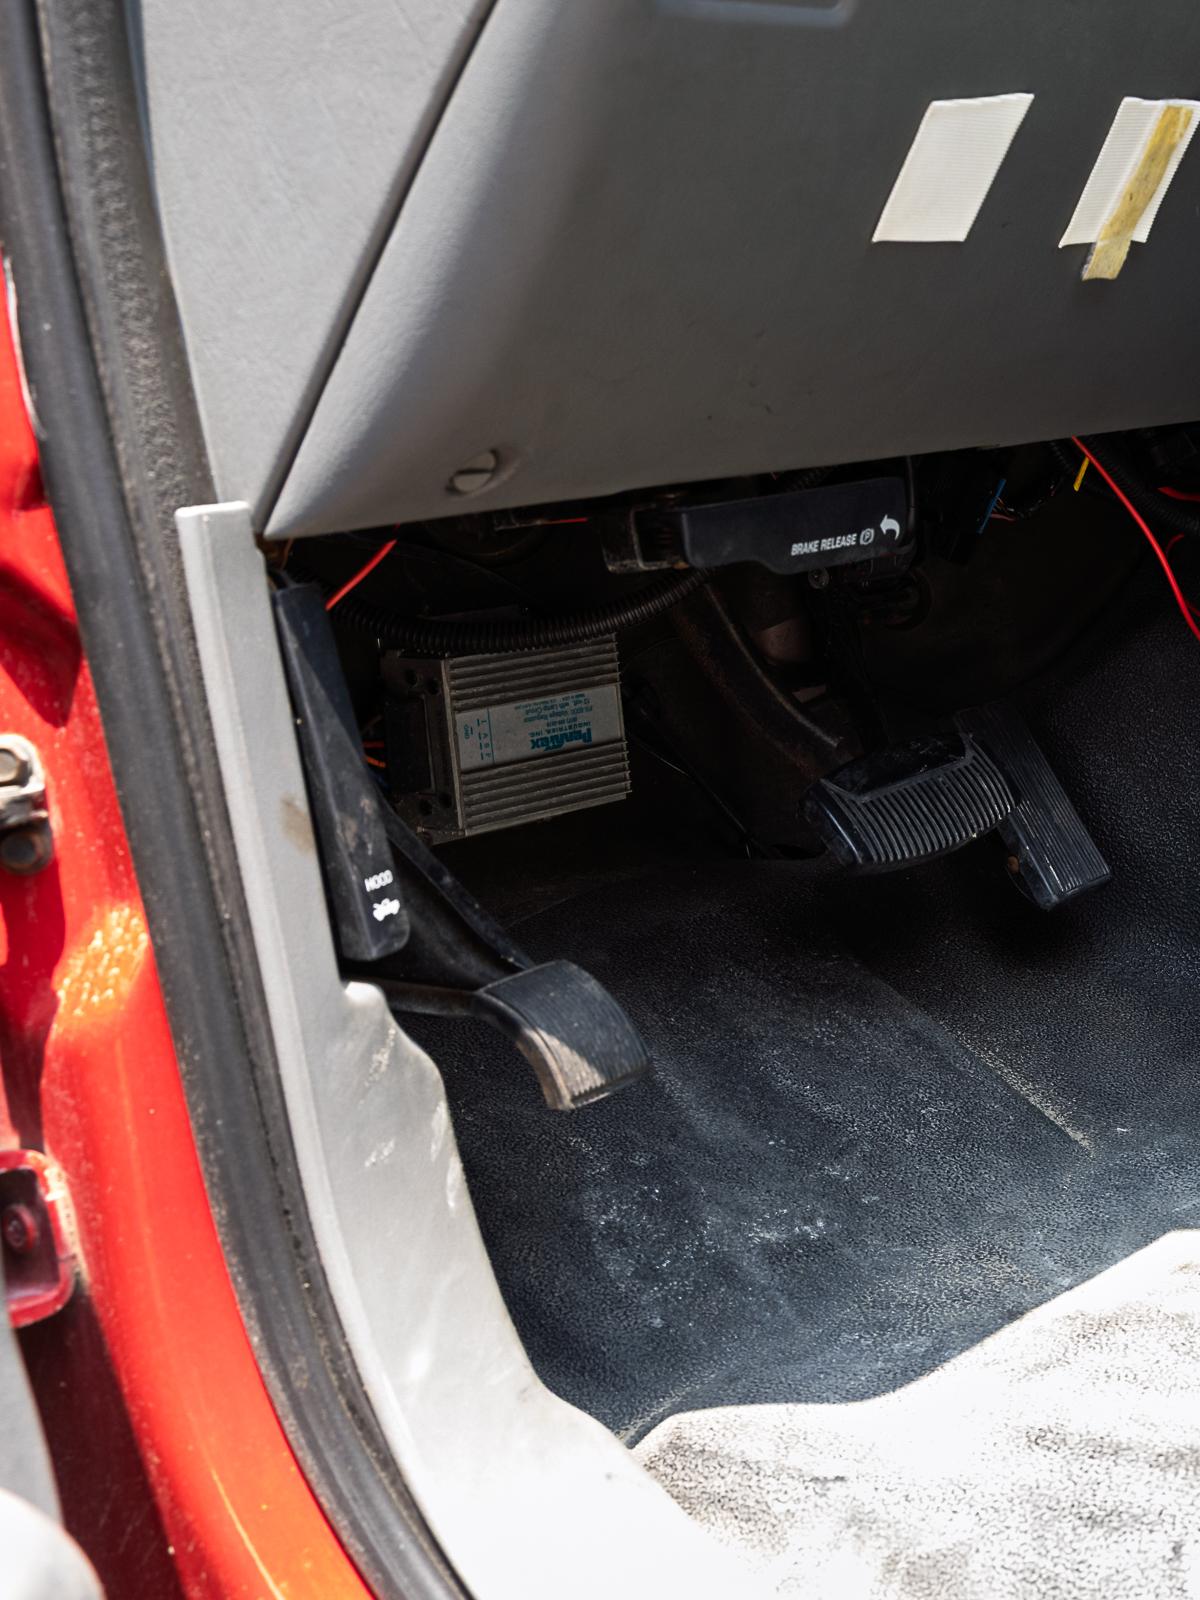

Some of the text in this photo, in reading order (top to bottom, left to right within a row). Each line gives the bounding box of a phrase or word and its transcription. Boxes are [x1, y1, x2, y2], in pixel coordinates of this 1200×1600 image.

[791, 540, 819, 556] BRAKE
[820, 533, 857, 551] RELEASE
[364, 869, 393, 892] HOOD
